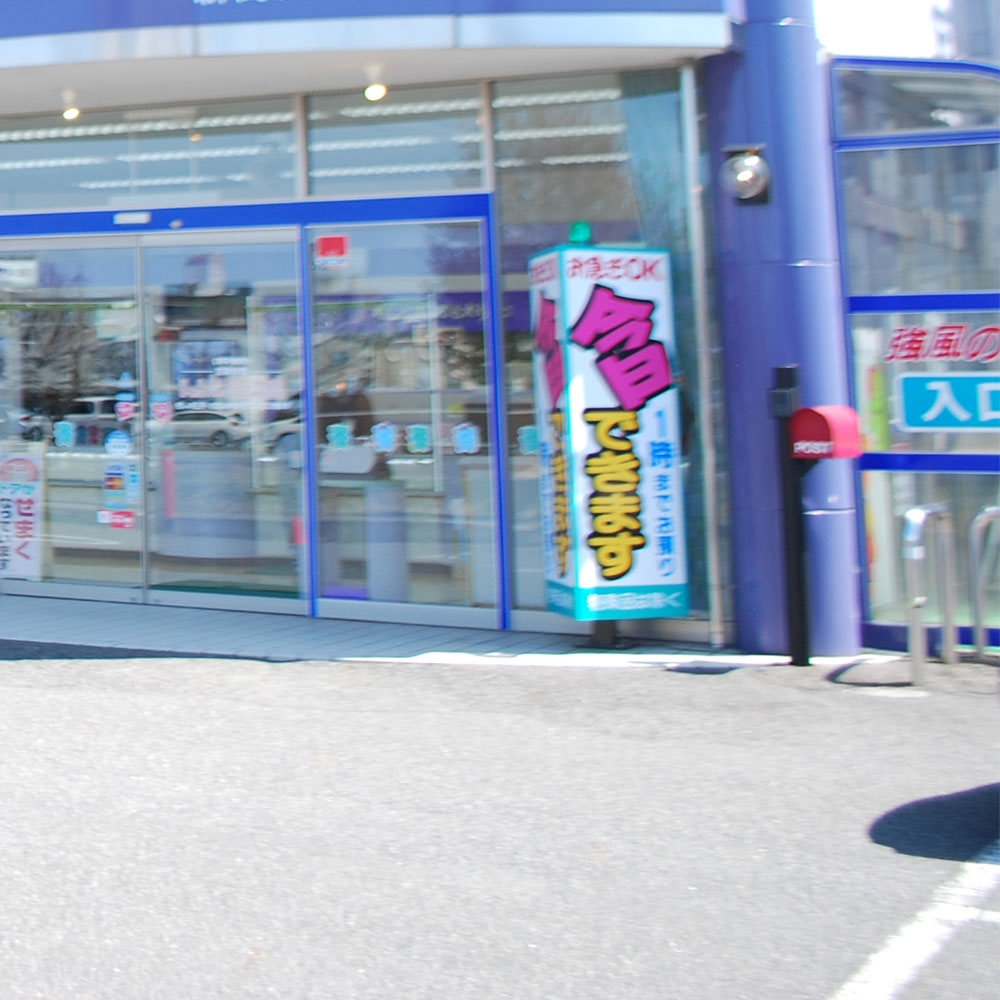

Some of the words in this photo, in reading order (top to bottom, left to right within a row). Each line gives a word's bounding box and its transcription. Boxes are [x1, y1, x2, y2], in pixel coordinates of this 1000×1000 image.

[793, 441, 833, 454] POST
[583, 408, 646, 580] できます
